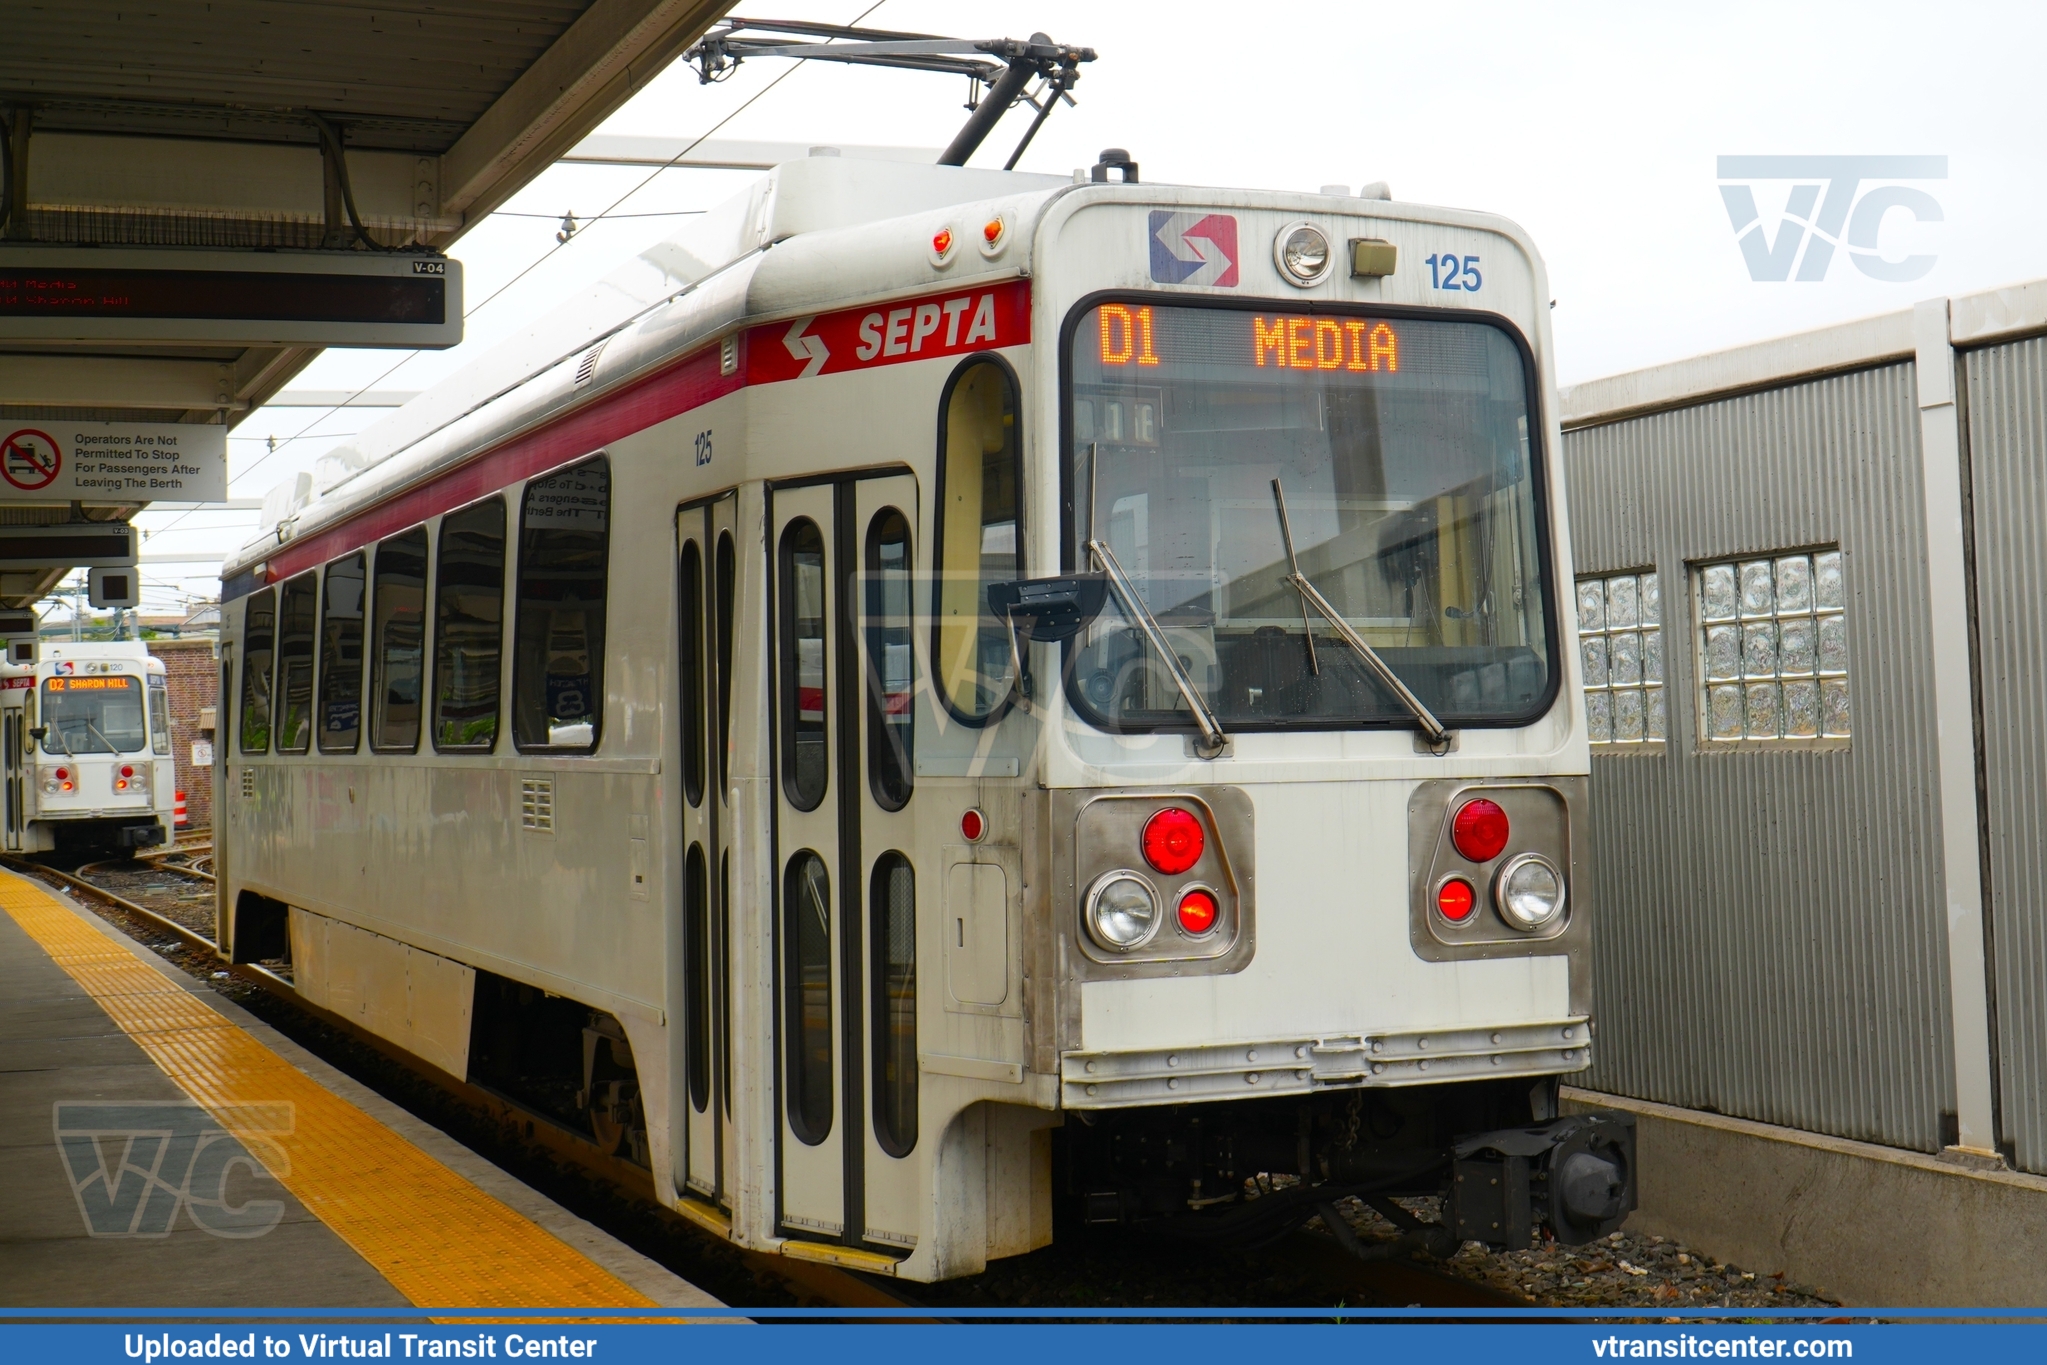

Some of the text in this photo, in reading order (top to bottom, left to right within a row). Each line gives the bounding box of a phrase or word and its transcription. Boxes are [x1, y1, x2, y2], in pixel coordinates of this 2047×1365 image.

[414, 262, 444, 273] V-04
[1425, 253, 1483, 292] 125
[856, 293, 996, 361] SEPTA
[1099, 304, 1398, 372] D1 MEDIA
[75, 434, 178, 446] Operators Are Not
[694, 429, 713, 467] 125
[75, 448, 180, 462] Permitted To Stop
[75, 463, 201, 476] For Passengers After
[75, 477, 182, 489] Leaving The Berth
[13, 677, 30, 687] SEPTA
[49, 678, 129, 691] D2 SHARON HILL
